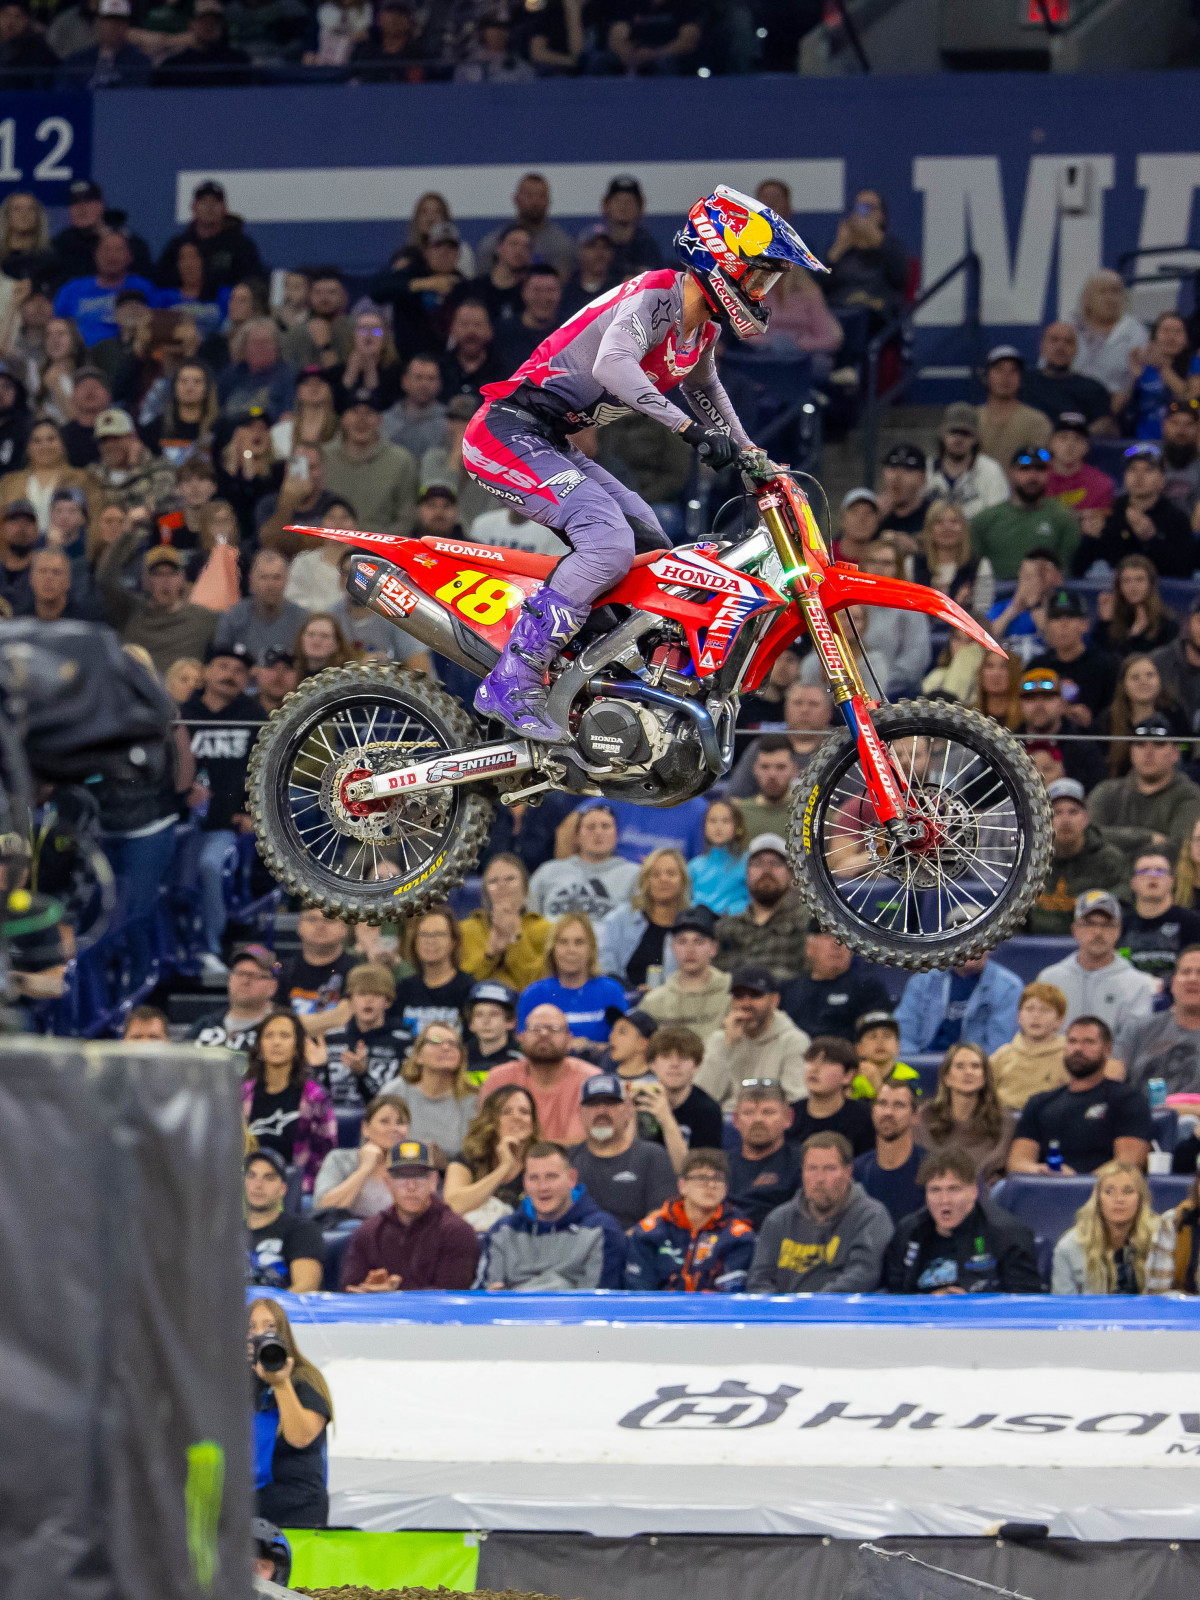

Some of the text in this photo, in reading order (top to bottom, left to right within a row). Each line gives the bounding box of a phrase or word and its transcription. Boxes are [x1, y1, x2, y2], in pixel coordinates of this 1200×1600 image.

[691, 390, 733, 438] HONDA
[477, 480, 525, 505] HONDA
[558, 475, 587, 499] HONDA
[322, 528, 396, 544] DUNLOP
[435, 541, 505, 562] HONDA
[661, 565, 742, 593] HONDA
[434, 569, 525, 626] 18
[708, 596, 756, 631] CRF
[807, 606, 844, 670] SHOWA
[590, 734, 624, 744] HONDA
[860, 724, 896, 800] DUNLOP
[803, 784, 820, 849] DUNLOP
[393, 855, 444, 895] DUNLOP
